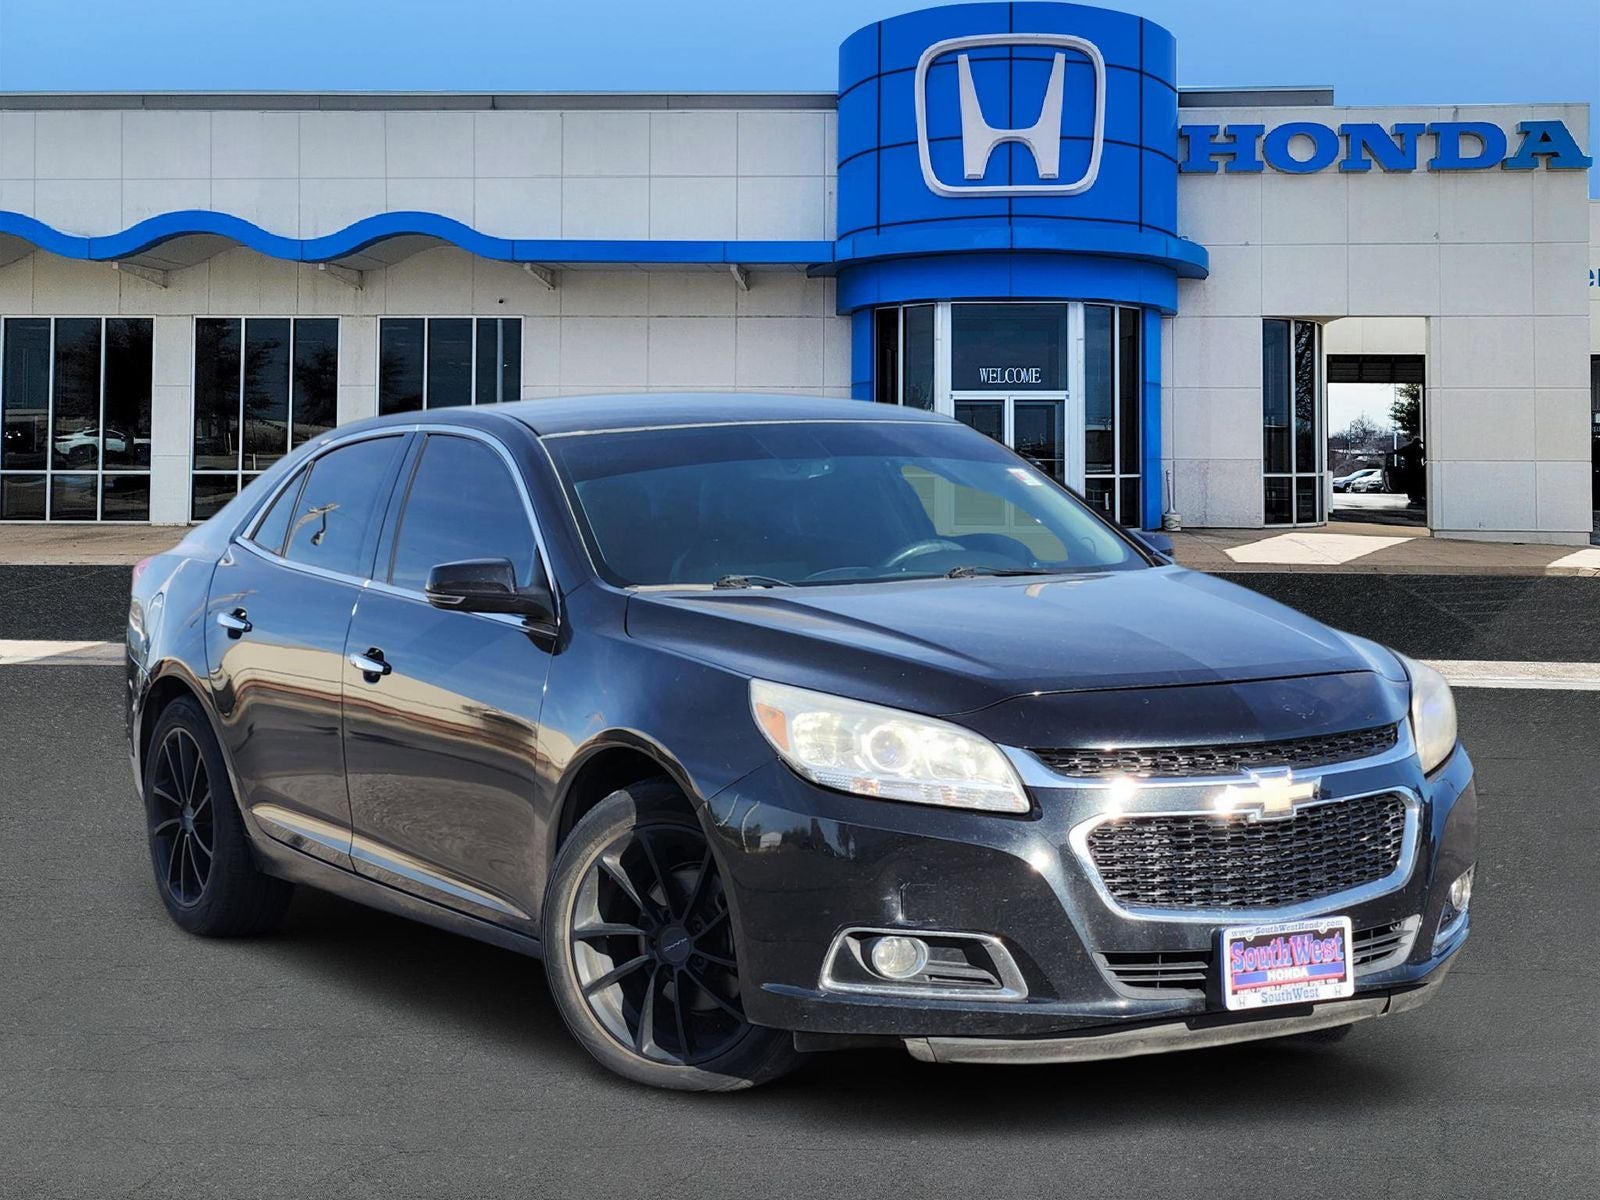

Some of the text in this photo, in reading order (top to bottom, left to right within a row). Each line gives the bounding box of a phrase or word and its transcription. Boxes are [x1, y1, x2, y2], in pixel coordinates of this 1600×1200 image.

[1179, 120, 1593, 174] HONDA
[979, 367, 1041, 384] WELCOME
[1267, 967, 1309, 983] HONDA
[1261, 987, 1320, 1004] SouthWest
